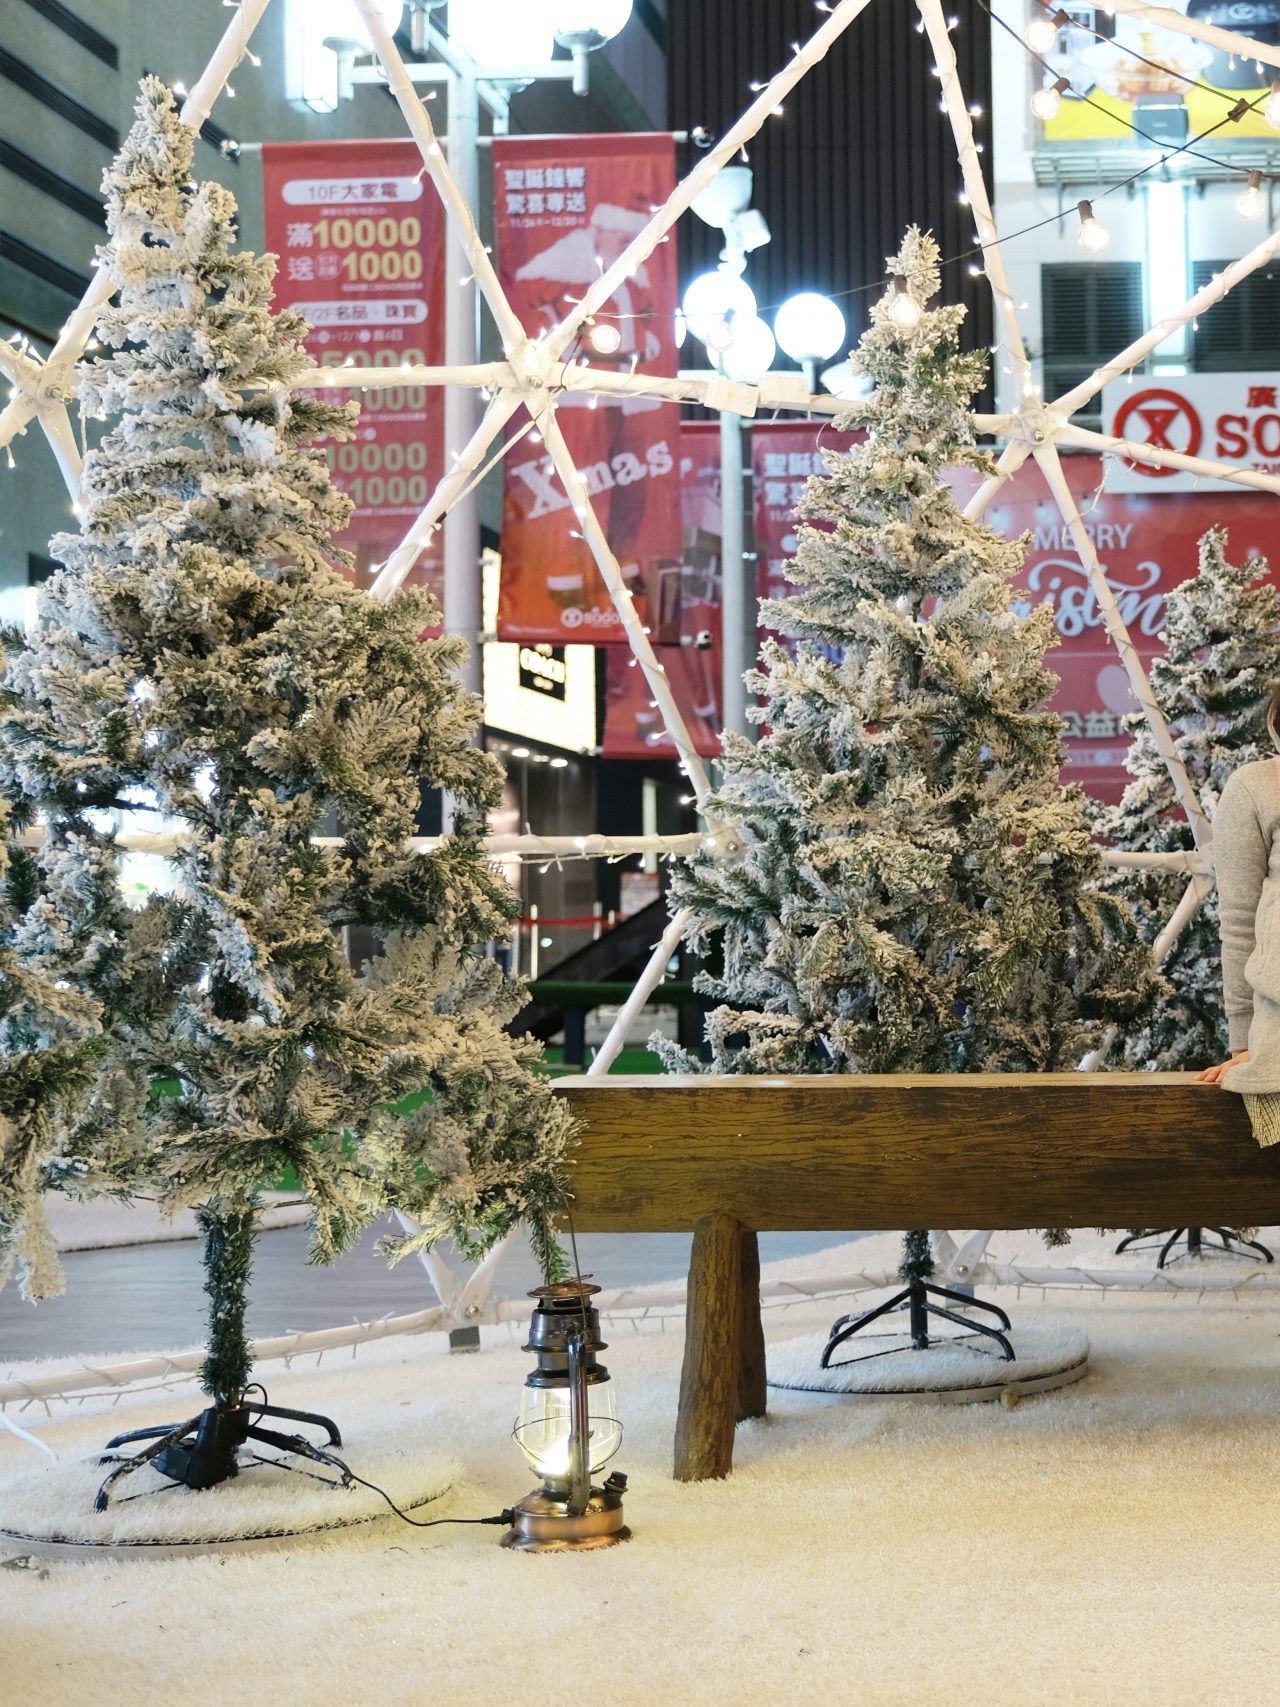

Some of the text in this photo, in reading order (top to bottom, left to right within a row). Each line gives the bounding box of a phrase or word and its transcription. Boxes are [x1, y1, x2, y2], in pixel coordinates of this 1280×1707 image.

[307, 182, 399, 200] 10F大家電
[342, 249, 424, 282] 1000
